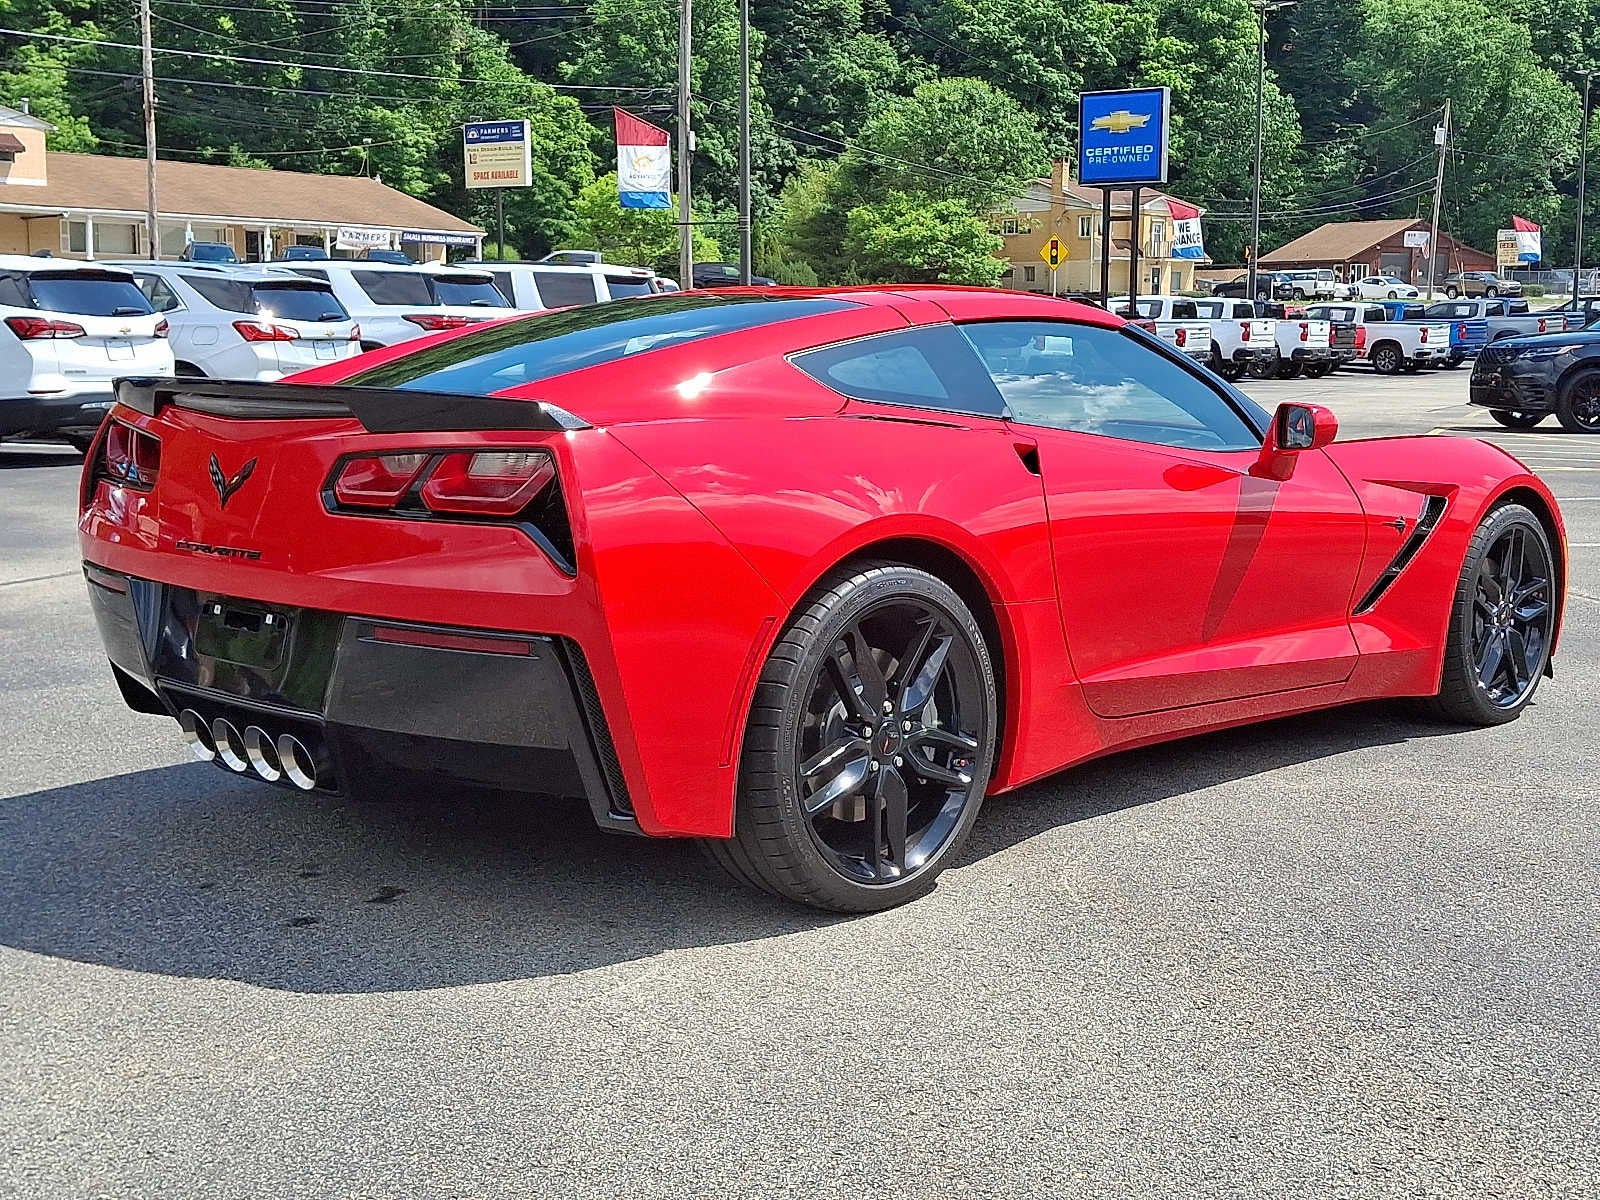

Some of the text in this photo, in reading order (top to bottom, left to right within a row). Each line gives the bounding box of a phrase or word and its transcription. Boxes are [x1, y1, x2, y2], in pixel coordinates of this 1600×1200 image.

[1086, 145, 1153, 157] CERTIFIED
[1088, 154, 1150, 165] PRE-OWNED
[473, 170, 519, 180] SPACE AVAILABLE
[1178, 222, 1190, 232] WE
[342, 231, 387, 241] FARMERS
[403, 232, 475, 244] SMALL BUSINESS INSURANCE
[1174, 232, 1201, 246] NANCE
[176, 541, 261, 560] CORVETTE
